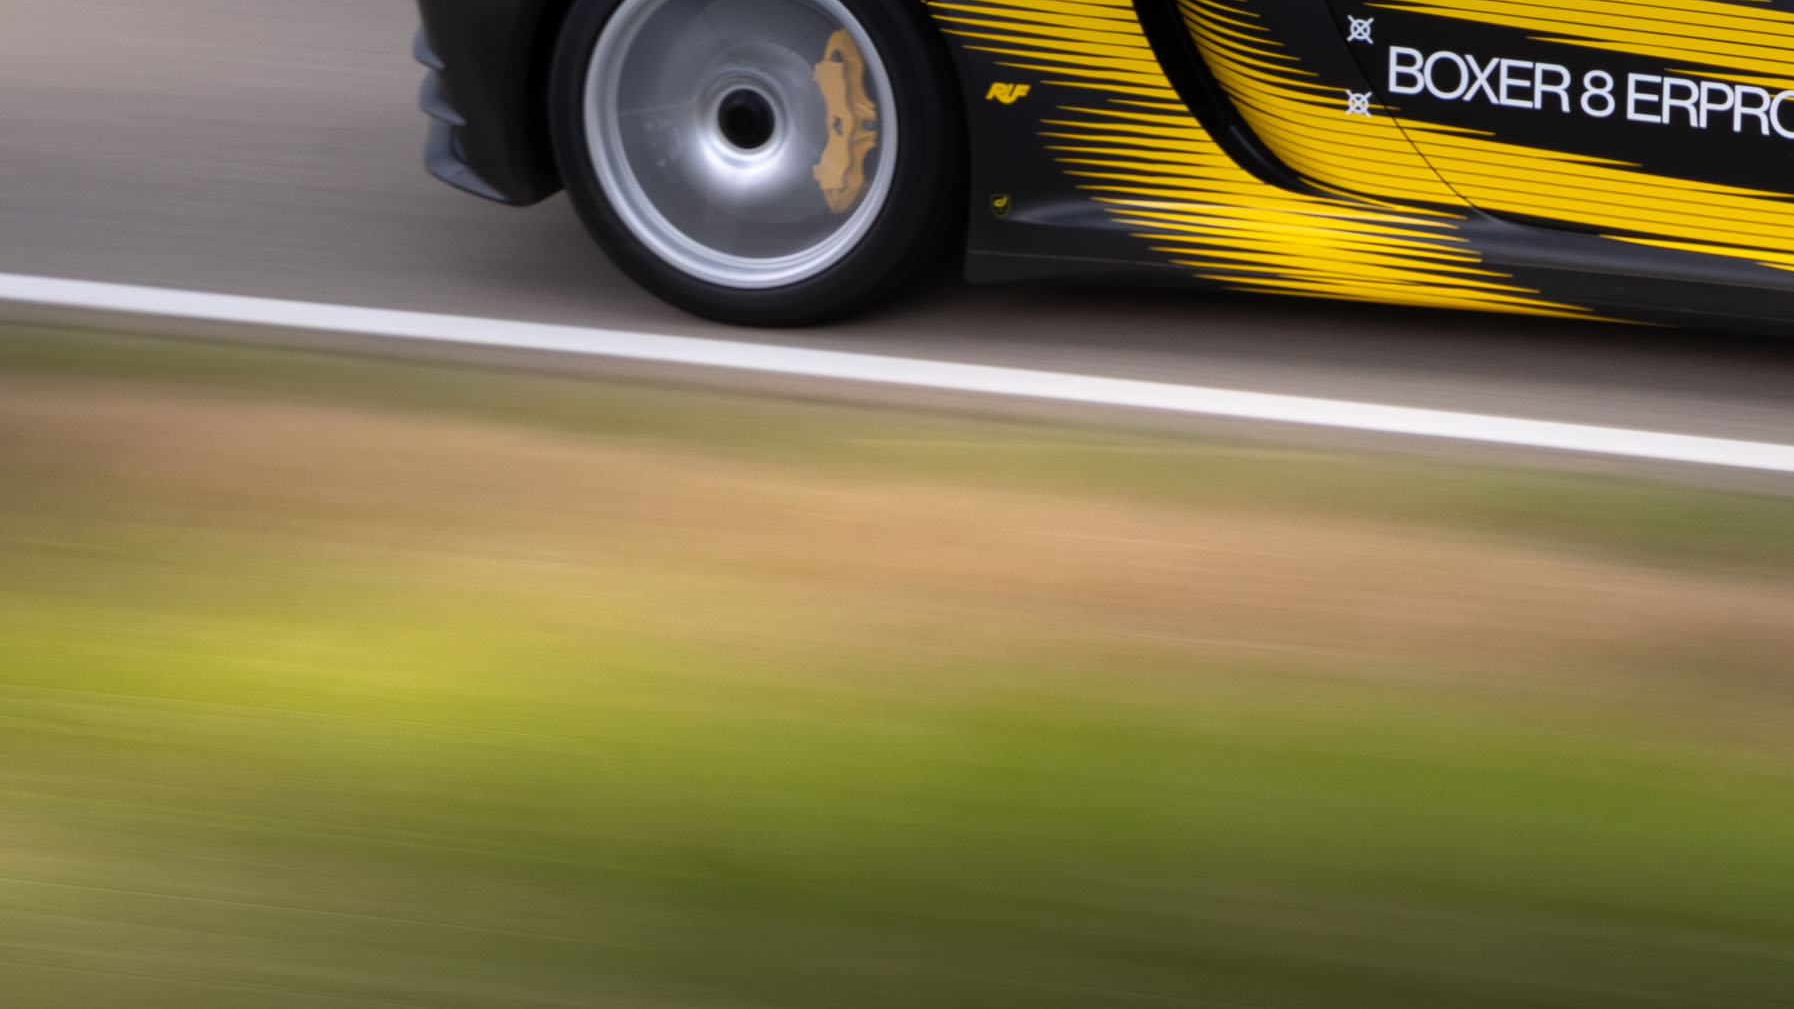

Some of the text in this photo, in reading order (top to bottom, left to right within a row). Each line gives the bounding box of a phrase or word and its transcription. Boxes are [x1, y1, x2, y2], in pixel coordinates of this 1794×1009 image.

[985, 81, 1031, 105] RUF
[1388, 45, 1571, 113] BOXER
[1580, 69, 1615, 118] 8
